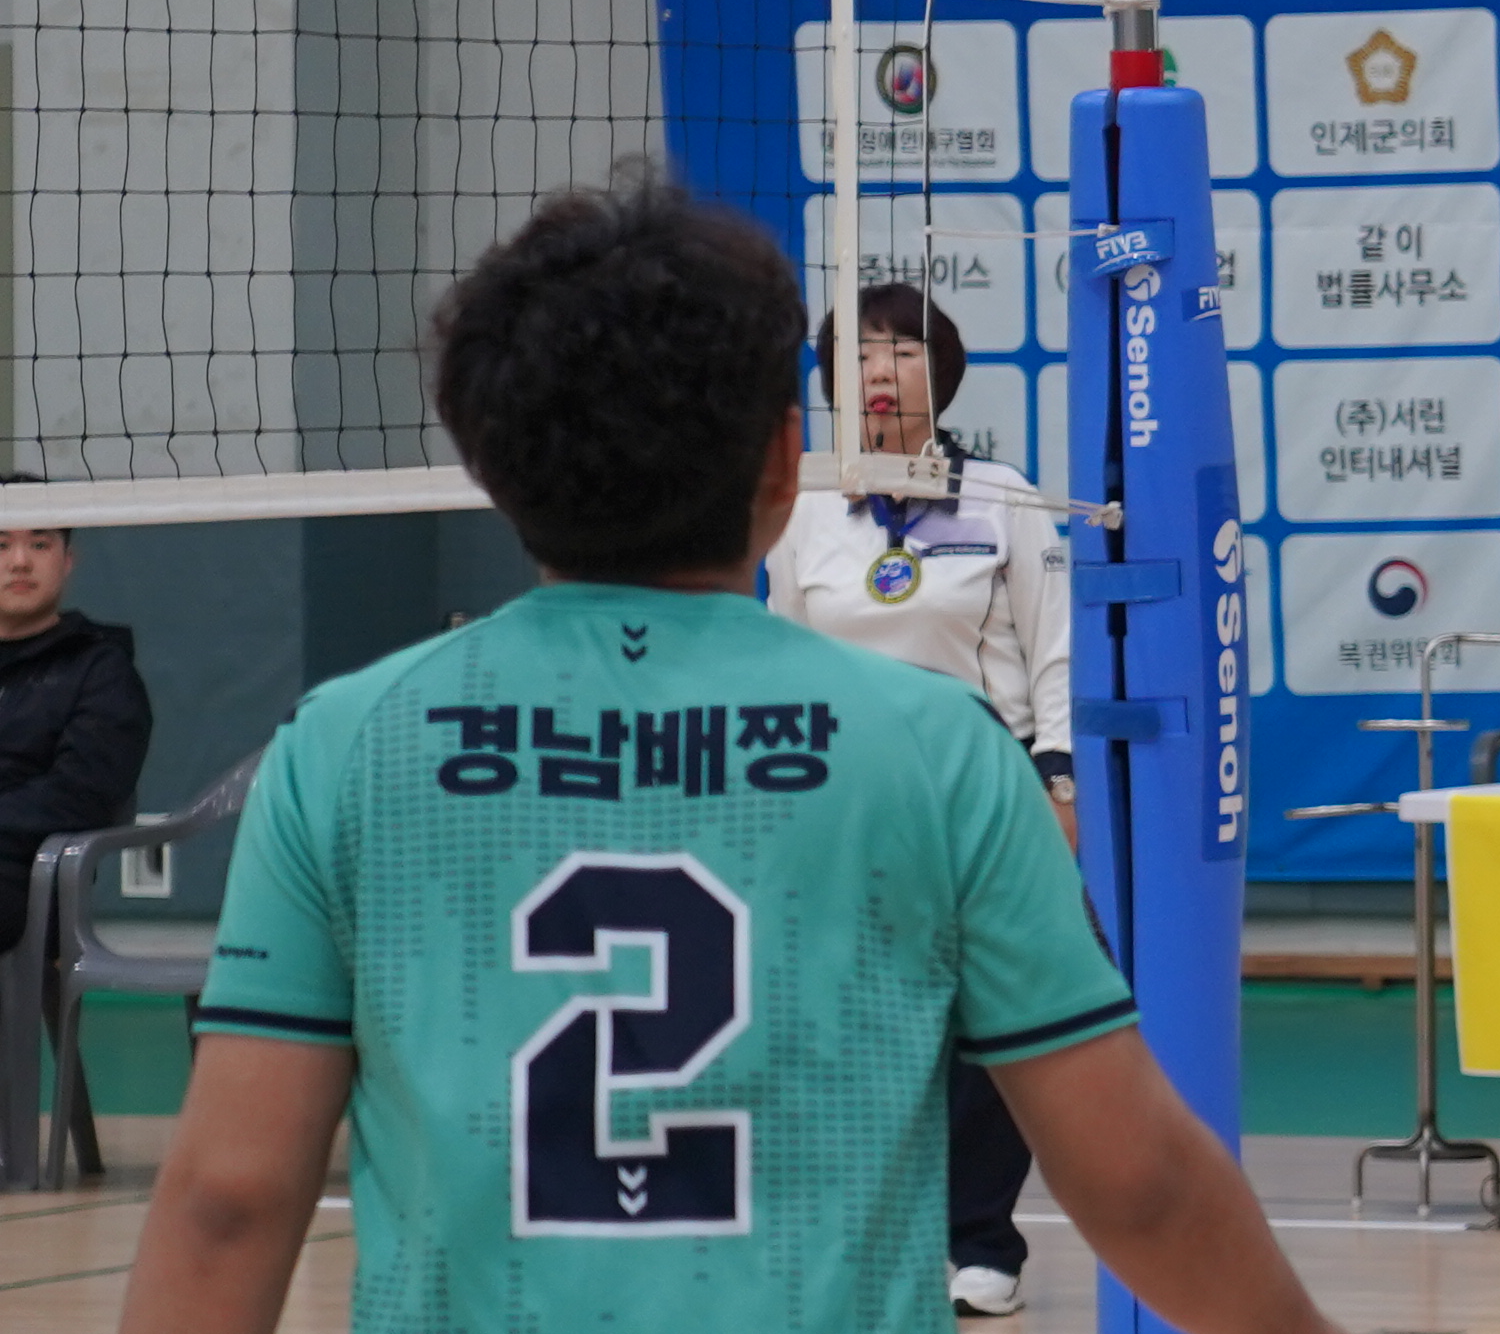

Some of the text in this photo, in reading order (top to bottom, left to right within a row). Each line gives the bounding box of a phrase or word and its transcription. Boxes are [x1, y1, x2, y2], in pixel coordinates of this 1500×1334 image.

[1310, 117, 1456, 156] 인제군의회
[1316, 268, 1468, 308] 법률사무소
[1126, 304, 1160, 449] Senoh
[1335, 398, 1446, 437] (주)서린
[1319, 444, 1463, 484] 인터내셔널
[426, 701, 838, 801] 경남배짱
[1216, 591, 1245, 844] Senoh
[511, 851, 751, 1237] 2
